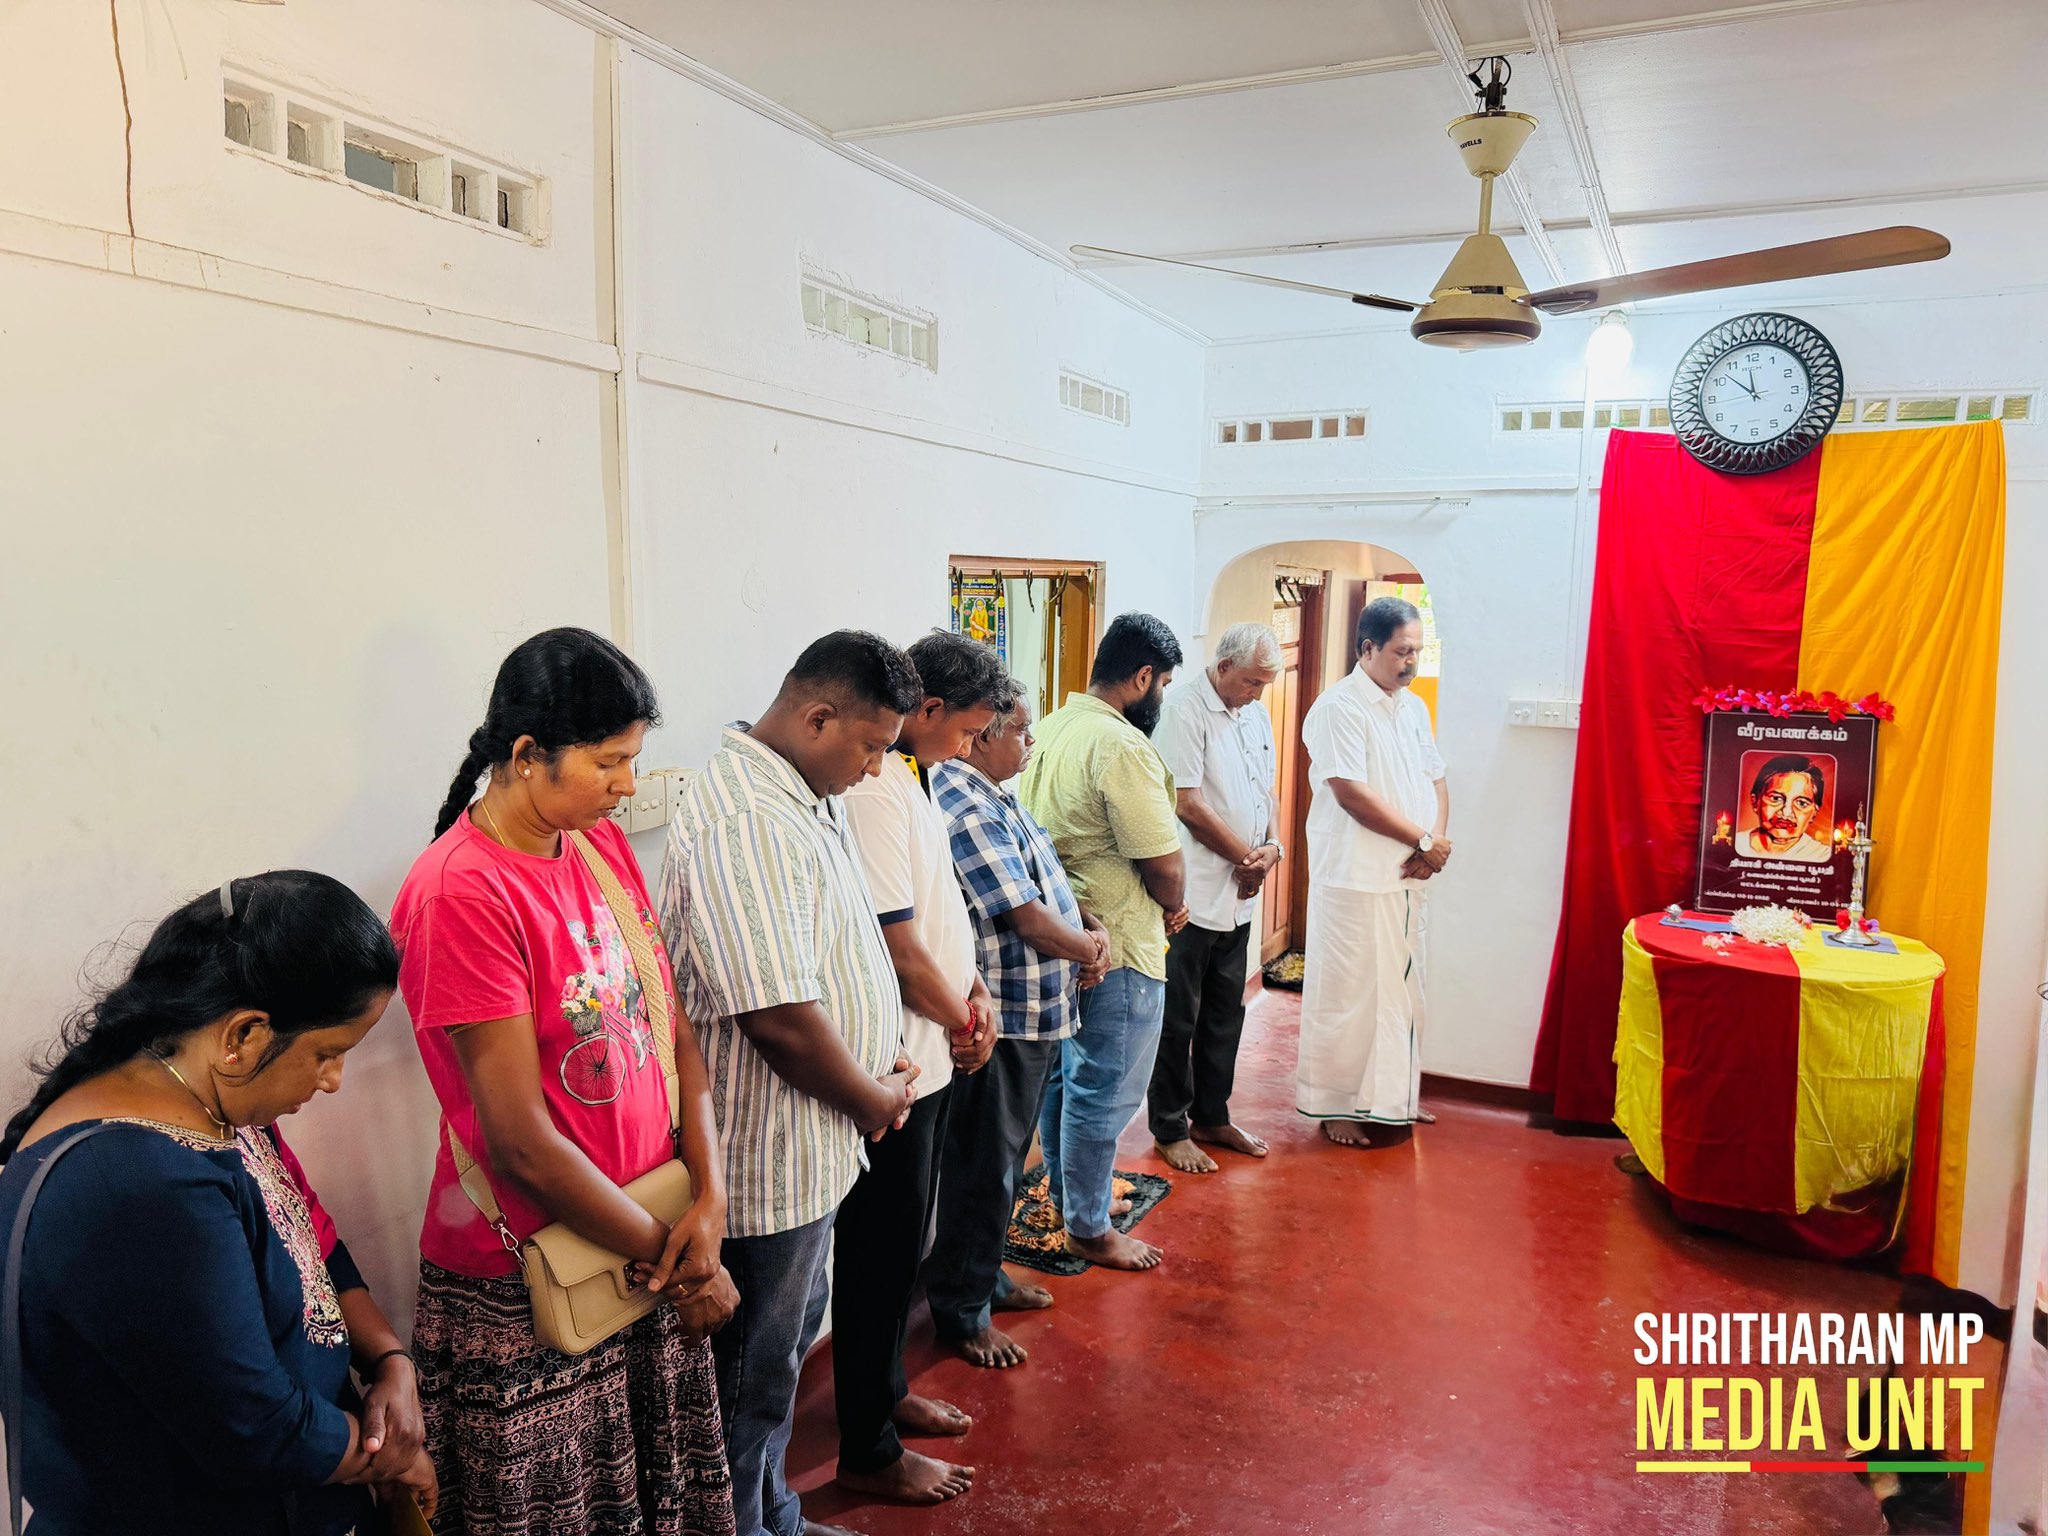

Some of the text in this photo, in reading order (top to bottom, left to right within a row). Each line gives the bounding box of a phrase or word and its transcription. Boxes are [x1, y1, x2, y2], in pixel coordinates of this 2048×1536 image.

[1745, 352, 1760, 362] 12
[1769, 356, 1776, 365] 1
[1726, 361, 1738, 371] 11
[1783, 369, 1793, 378] 2
[1713, 376, 1727, 387] 10
[1790, 385, 1799, 395] 3
[1707, 395, 1717, 404] 9
[1783, 404, 1793, 413] 4
[1716, 412, 1724, 422] 8
[1769, 419, 1779, 428] 5
[1730, 424, 1739, 434] 7
[1737, 721, 1848, 742] வீரவணக்கம்
